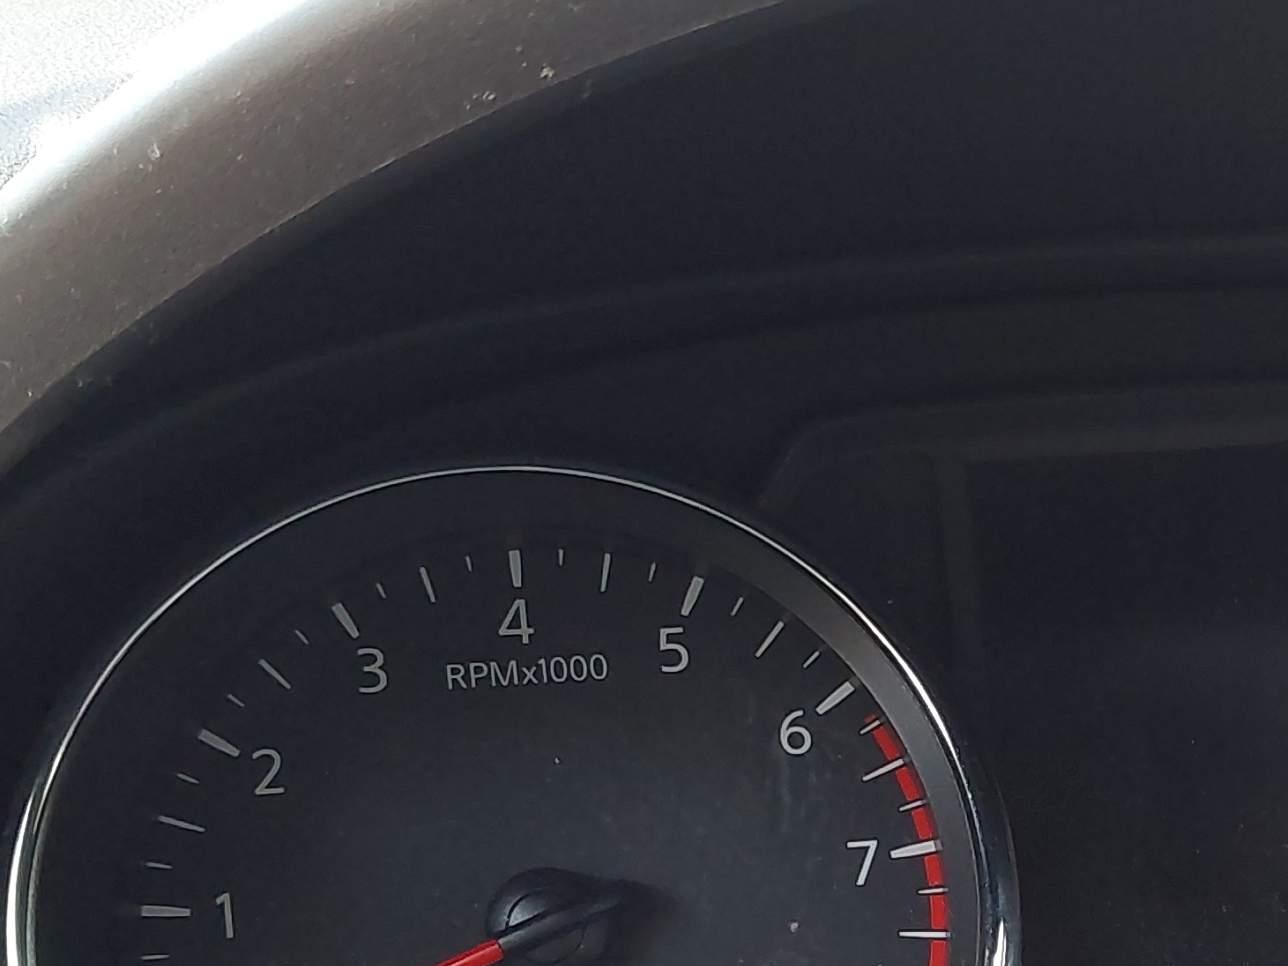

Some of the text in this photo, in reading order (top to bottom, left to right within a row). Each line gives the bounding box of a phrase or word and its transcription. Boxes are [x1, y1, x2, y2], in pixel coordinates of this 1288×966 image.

[499, 598, 535, 645] 4
[357, 648, 388, 694] 3
[446, 654, 608, 690] RPMx1000
[658, 626, 689, 673] 5
[779, 710, 812, 755] 6
[252, 748, 285, 795] 2
[846, 839, 879, 886] 7
[215, 892, 234, 938] 1
